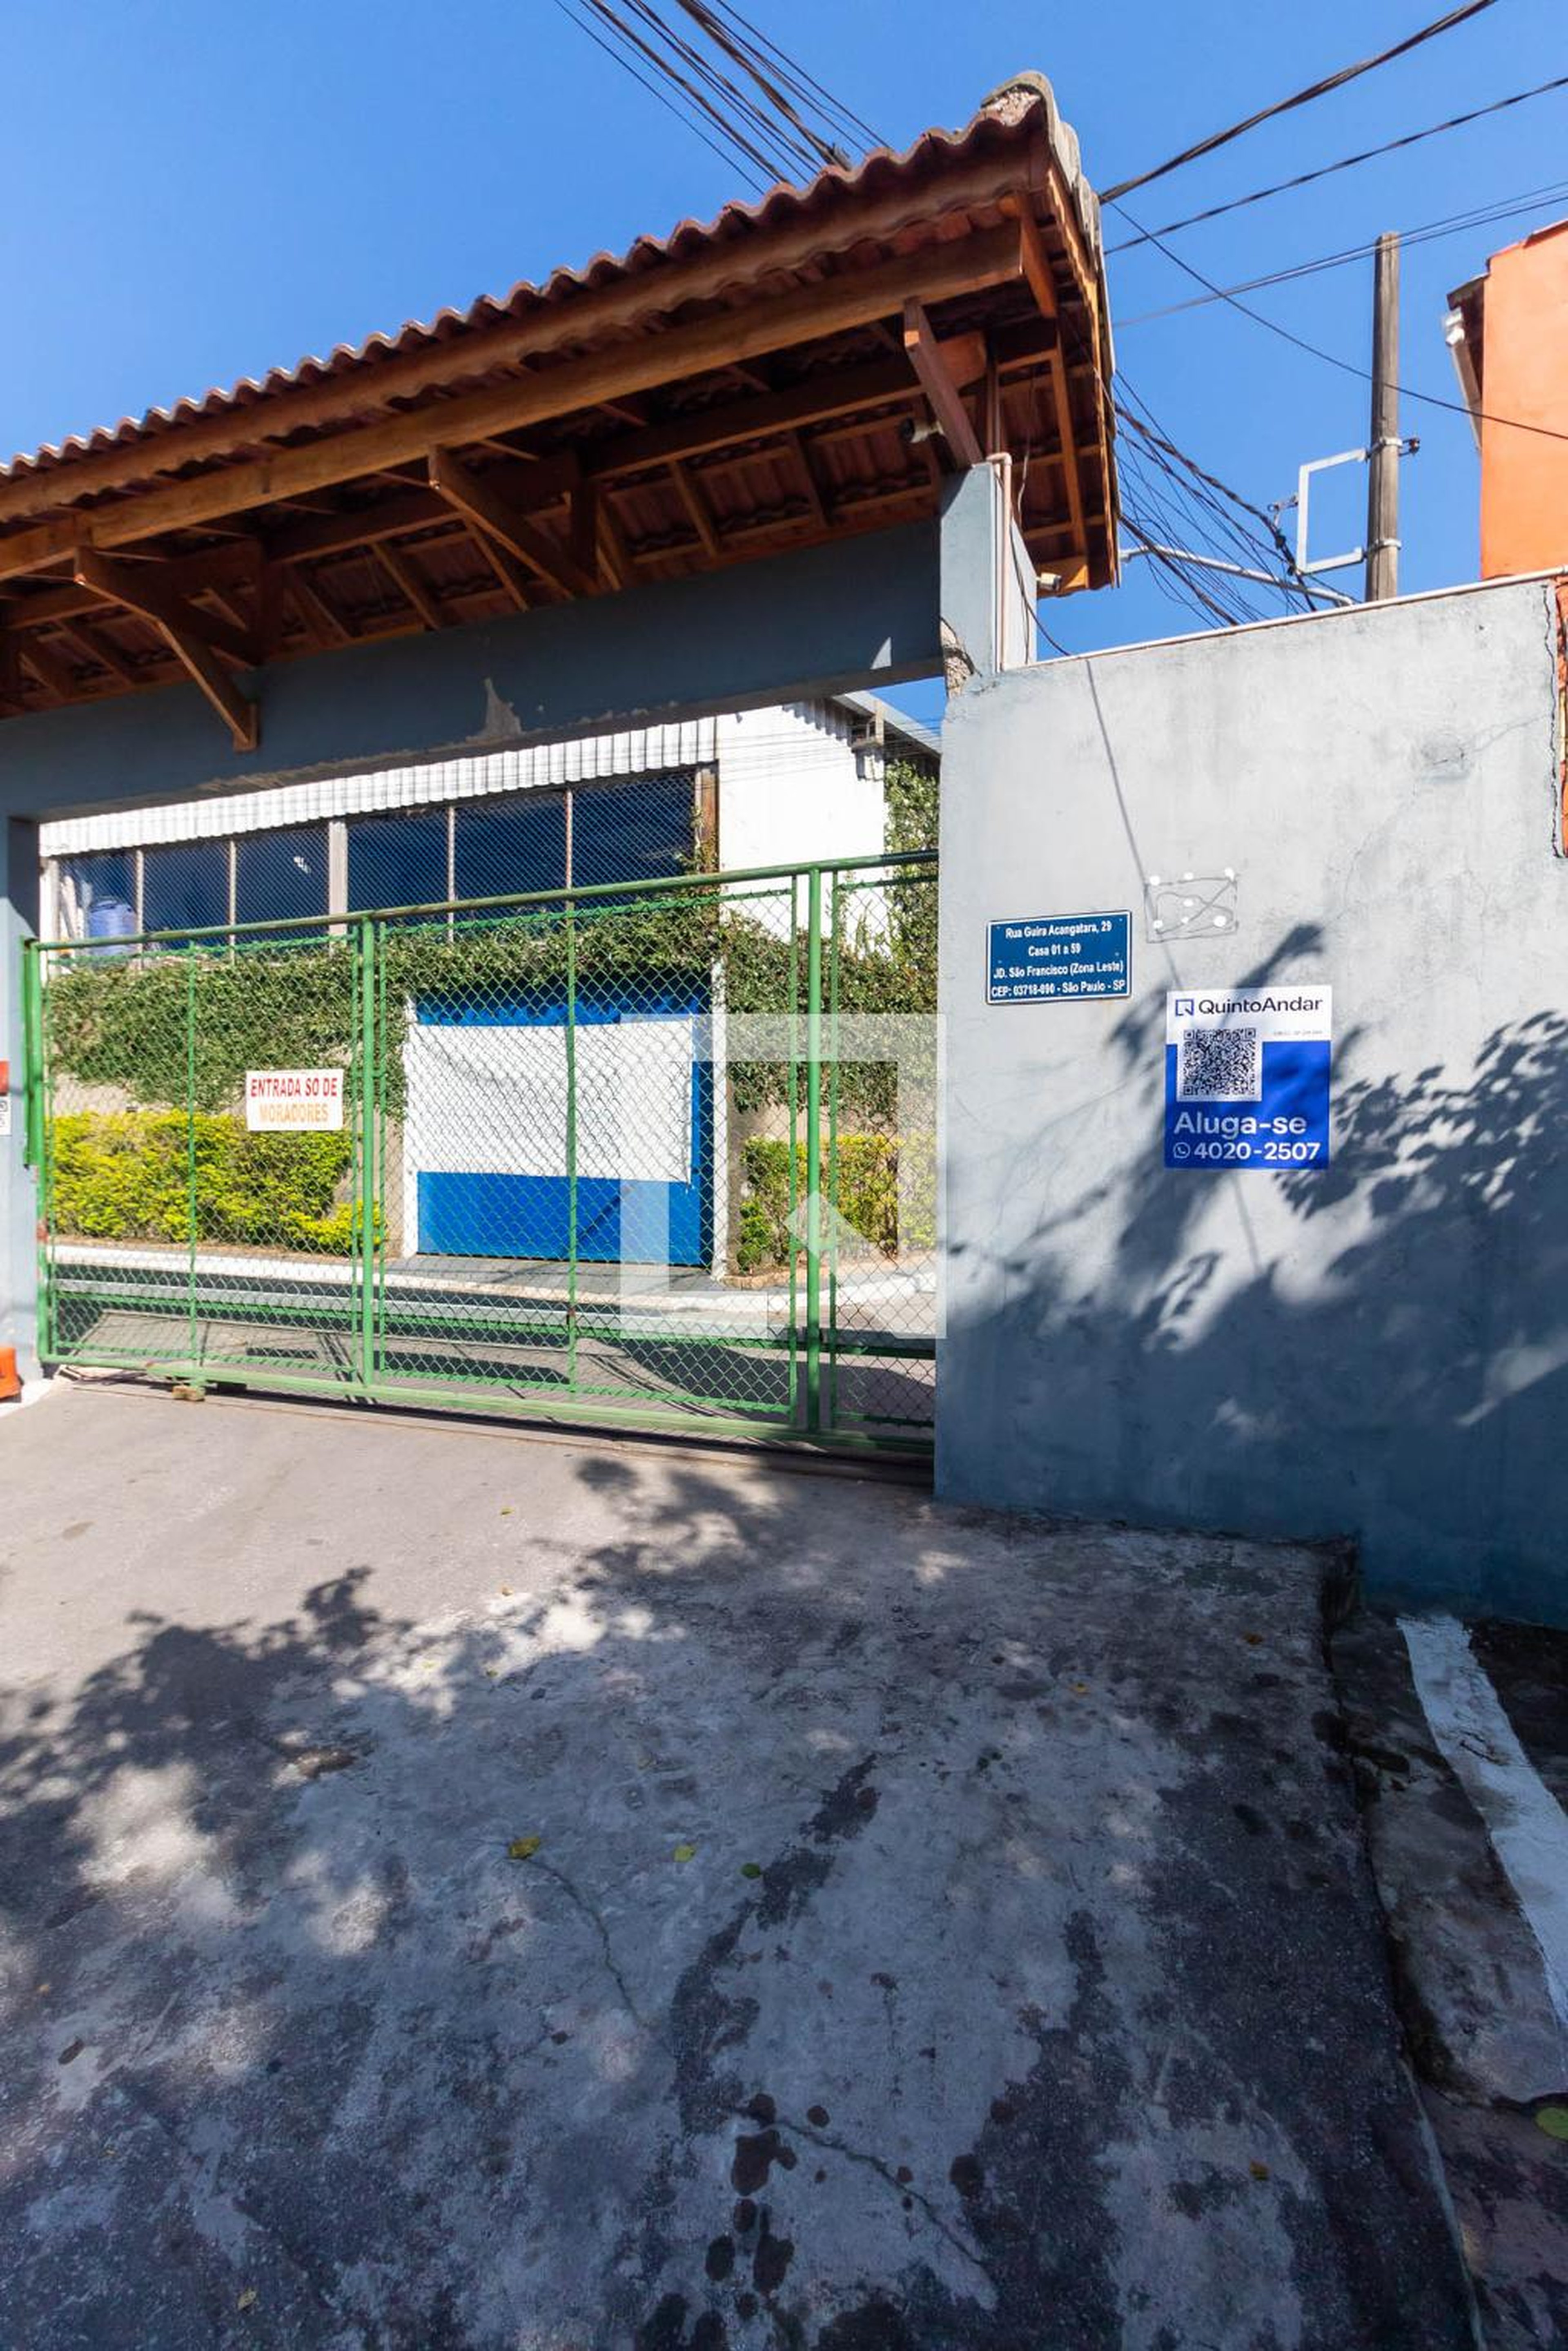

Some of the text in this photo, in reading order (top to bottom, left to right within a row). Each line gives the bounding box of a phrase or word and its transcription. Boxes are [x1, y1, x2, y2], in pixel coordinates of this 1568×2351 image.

[1005, 928, 1022, 939] Rua
[1028, 945, 1049, 957] Casa
[1051, 944, 1061, 955] 01
[1063, 946, 1069, 955] a
[993, 960, 1123, 979] JD. São Francisco (Zona Leste)
[991, 986, 1012, 997] CEP:
[1062, 981, 1079, 993] São
[1081, 980, 1105, 992] Paulo
[1113, 980, 1125, 990] SP
[1198, 997, 1323, 1015] QuintoAndar
[251, 1077, 301, 1097] ENTRADA
[323, 1077, 337, 1097] DE
[259, 1103, 329, 1122] MORADORES
[1174, 1112, 1306, 1139] Aluga-se
[1194, 1142, 1321, 1160] 4020-2507
